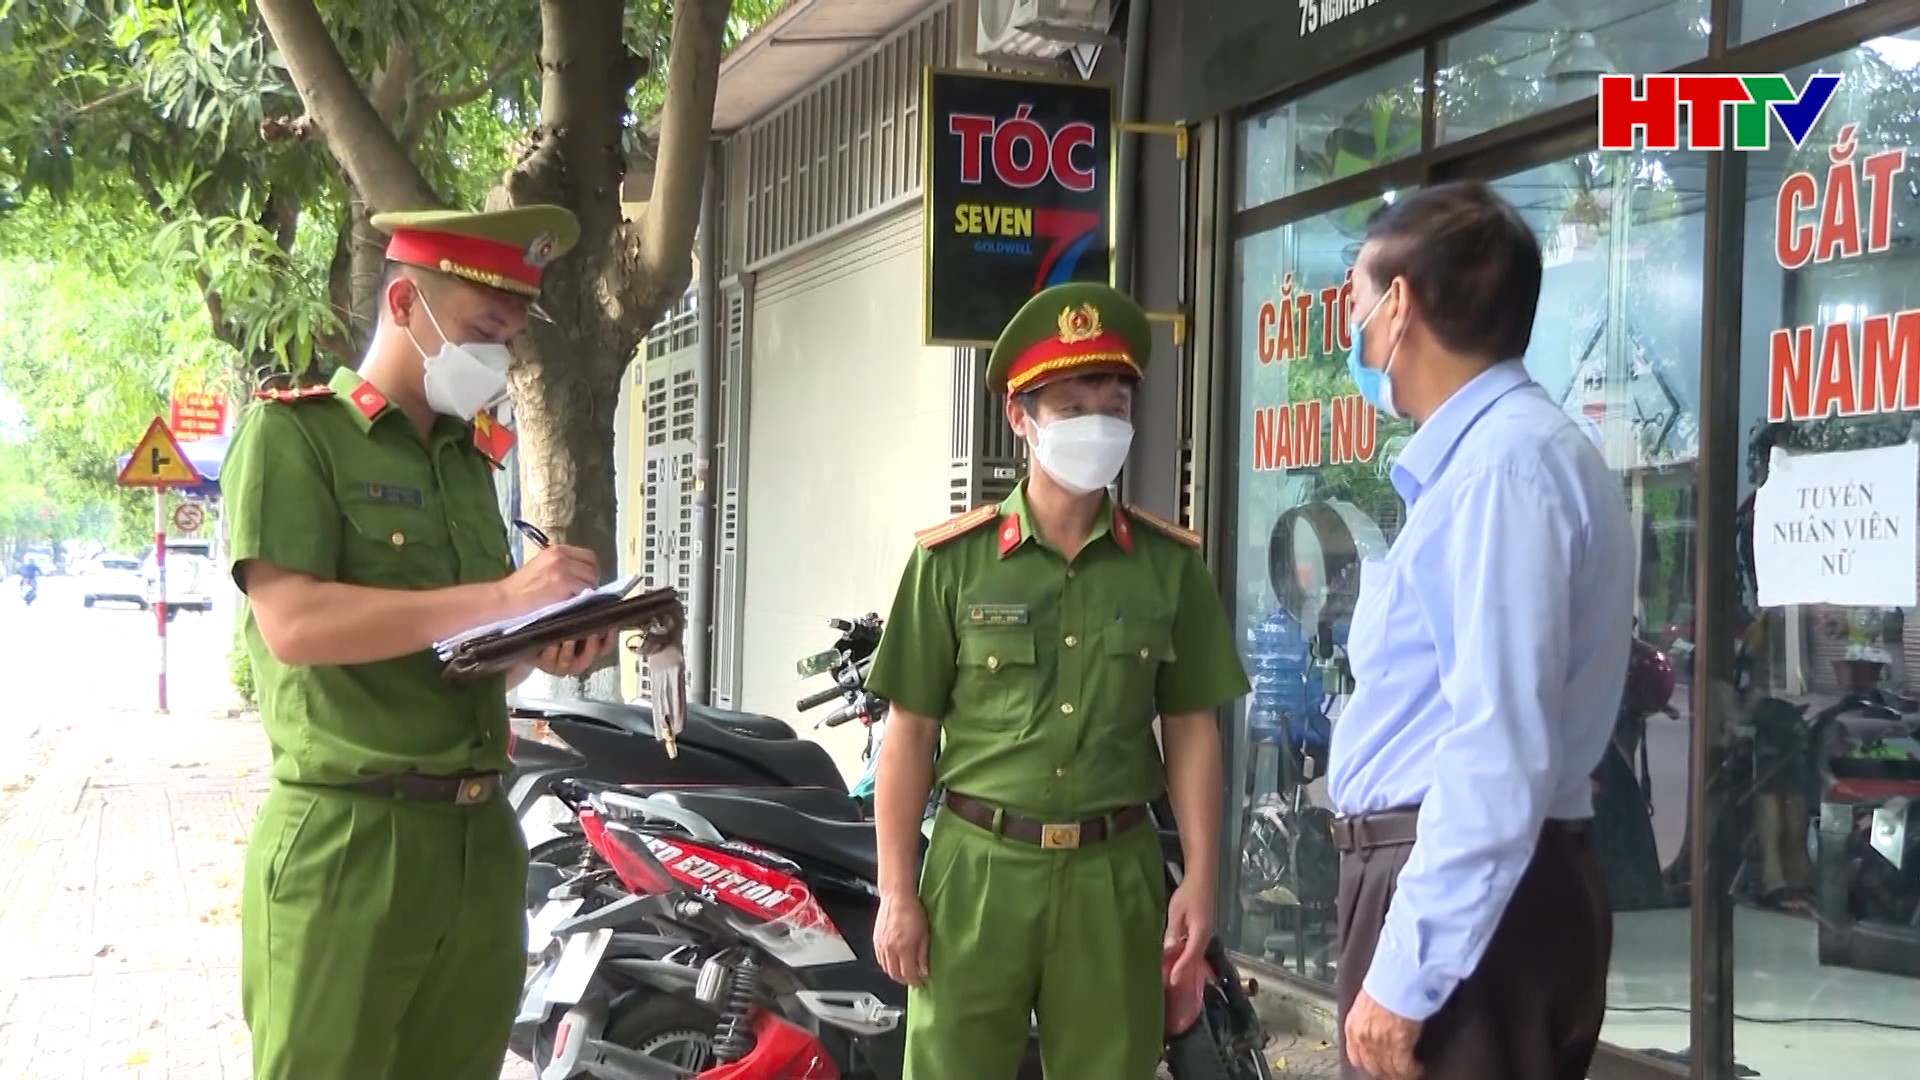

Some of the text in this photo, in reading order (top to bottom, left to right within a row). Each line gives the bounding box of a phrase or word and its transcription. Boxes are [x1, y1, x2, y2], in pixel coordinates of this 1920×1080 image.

[1299, 0, 1318, 37] 75
[950, 104, 1095, 190] TÓC
[955, 204, 1032, 237] SEVEN
[1775, 121, 1906, 269] CẮT
[974, 241, 1032, 256] GOLDWELL
[1257, 268, 1354, 364] CẮT TÓ
[1768, 309, 1920, 423] NAM
[1253, 399, 1322, 472] NAM
[1773, 511, 1900, 544] NHÂN VIÊN
[672, 855, 792, 908] EDITION
